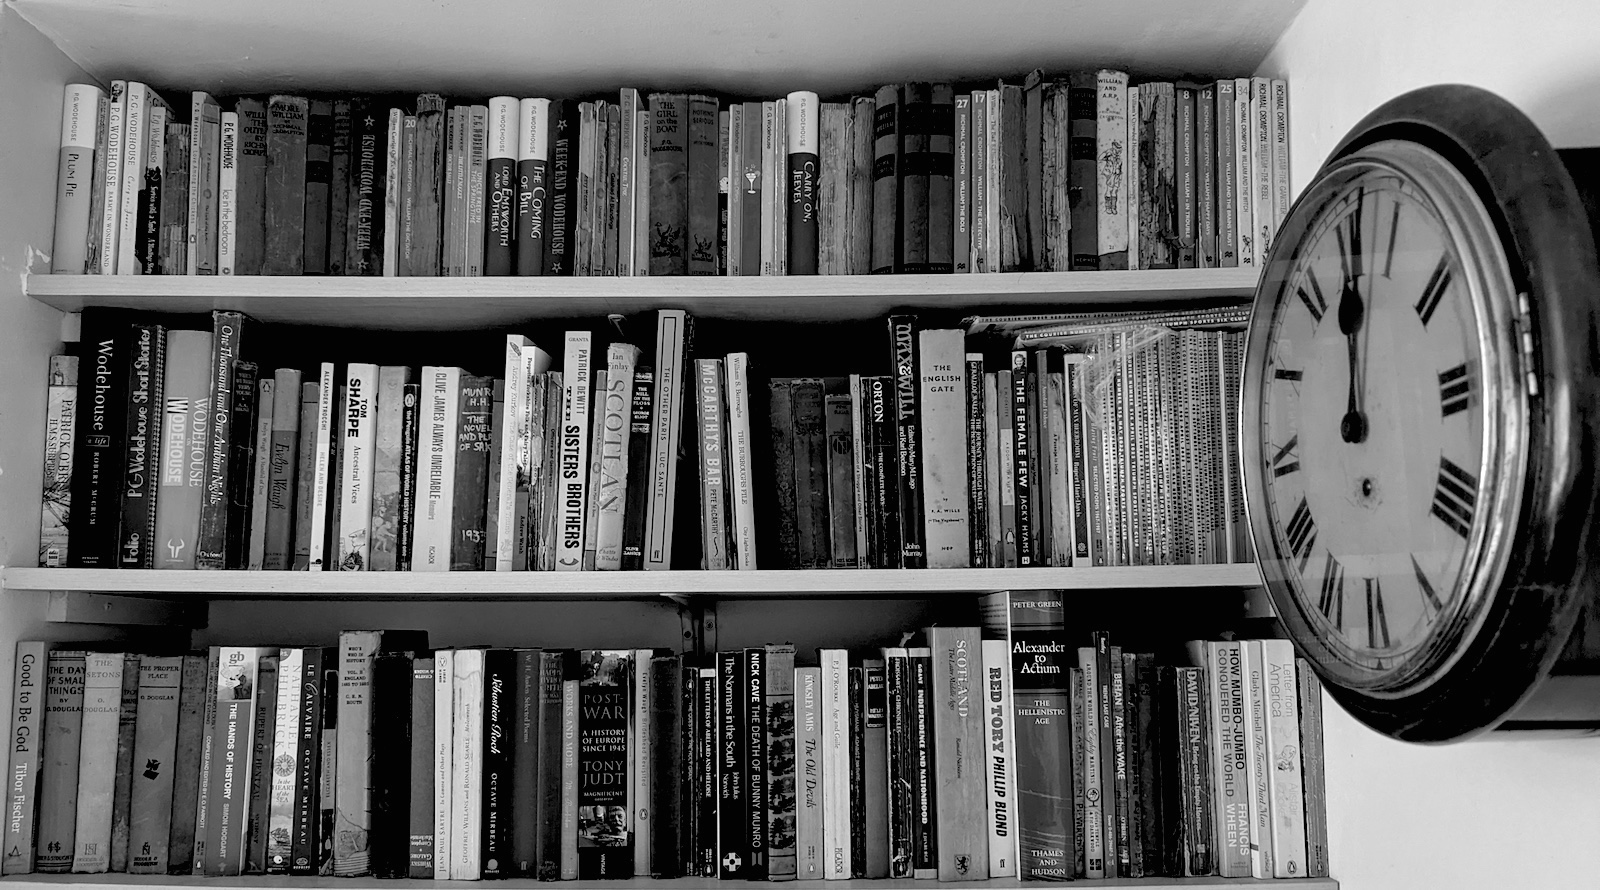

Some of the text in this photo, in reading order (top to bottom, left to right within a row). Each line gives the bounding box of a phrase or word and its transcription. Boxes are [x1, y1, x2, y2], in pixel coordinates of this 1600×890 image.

[956, 99, 968, 108] 27
[975, 94, 985, 103] 17
[1183, 91, 1190, 100] 8
[1202, 90, 1212, 99] 12
[1221, 84, 1232, 94] 25
[1259, 83, 1267, 108] RICHMAL
[405, 119, 416, 128] 20
[1276, 85, 1287, 215] RICHMAL CROMPTON GANGSTER
[66, 154, 79, 197] PLUM PIE
[357, 135, 375, 250] WEEK-END WODEHOUSE
[520, 176, 531, 216] OF BILL
[531, 165, 546, 239] THE COMING
[552, 139, 568, 255] WEEK-END WODEHOUSE
[793, 170, 803, 204] JEEVES
[802, 161, 814, 223] CARRY ON,
[491, 191, 502, 232] OTHERS
[500, 166, 512, 246] LORD EMSWORTH
[1413, 250, 1452, 332] II
[92, 339, 114, 431] Wodehouse
[576, 349, 587, 415] PATRICK DEWITT
[663, 367, 671, 384] THE
[1016, 379, 1025, 405] THE
[1437, 358, 1478, 424] III
[59, 399, 73, 448] PATRICK
[208, 325, 233, 505] One Thousand and One Arabian Nights
[347, 378, 361, 438] SHARPE
[359, 398, 368, 418] TOM
[660, 417, 668, 441] PARIS
[1016, 409, 1027, 457] FEMALE
[167, 398, 188, 483] WODEHOUSE
[189, 398, 208, 487] WODEHOUSE
[428, 373, 447, 520] CLIVE JAMES ALWAYS UNRELIABLE Memoirs
[563, 425, 581, 479] SISTERS
[1272, 433, 1300, 481] IX
[270, 442, 290, 511] Evelyn Waugh
[351, 445, 362, 504] Ancestral Vices
[1018, 462, 1028, 488] FEW
[1428, 448, 1478, 542] IIII
[564, 483, 582, 549] BROTHERS
[1019, 495, 1028, 522] JACKY
[1286, 490, 1319, 576] VIII
[1318, 548, 1345, 634] VII
[1363, 576, 1391, 649] VI
[1013, 641, 1065, 653] Alexander
[1020, 662, 1060, 674] Actium
[275, 664, 289, 749] PHILBRICK
[288, 664, 301, 750] NATHANIEL
[956, 639, 969, 718] SCOTLAND
[1185, 671, 1201, 743] DAVID NIVEN
[1269, 663, 1283, 718] America
[1282, 663, 1295, 718] Letter from
[583, 706, 625, 720] WAR
[1218, 648, 1235, 797] CONQUERED THE WORLD
[1229, 648, 1245, 770] HOW MUMBO-JUMBO
[11, 654, 36, 833] Good to Be God Tibor Fischer
[582, 760, 624, 772] TONY
[750, 653, 762, 848] NICK CAVE THE DEATH OF BUNNY MUNRO
[989, 667, 1007, 838] RED TORY PHILLIP BLOND
[582, 773, 624, 788] JUDT
[1226, 803, 1238, 848] WHEEN
[1238, 803, 1250, 856] FRANCIS
[835, 847, 843, 874] PICADOR
